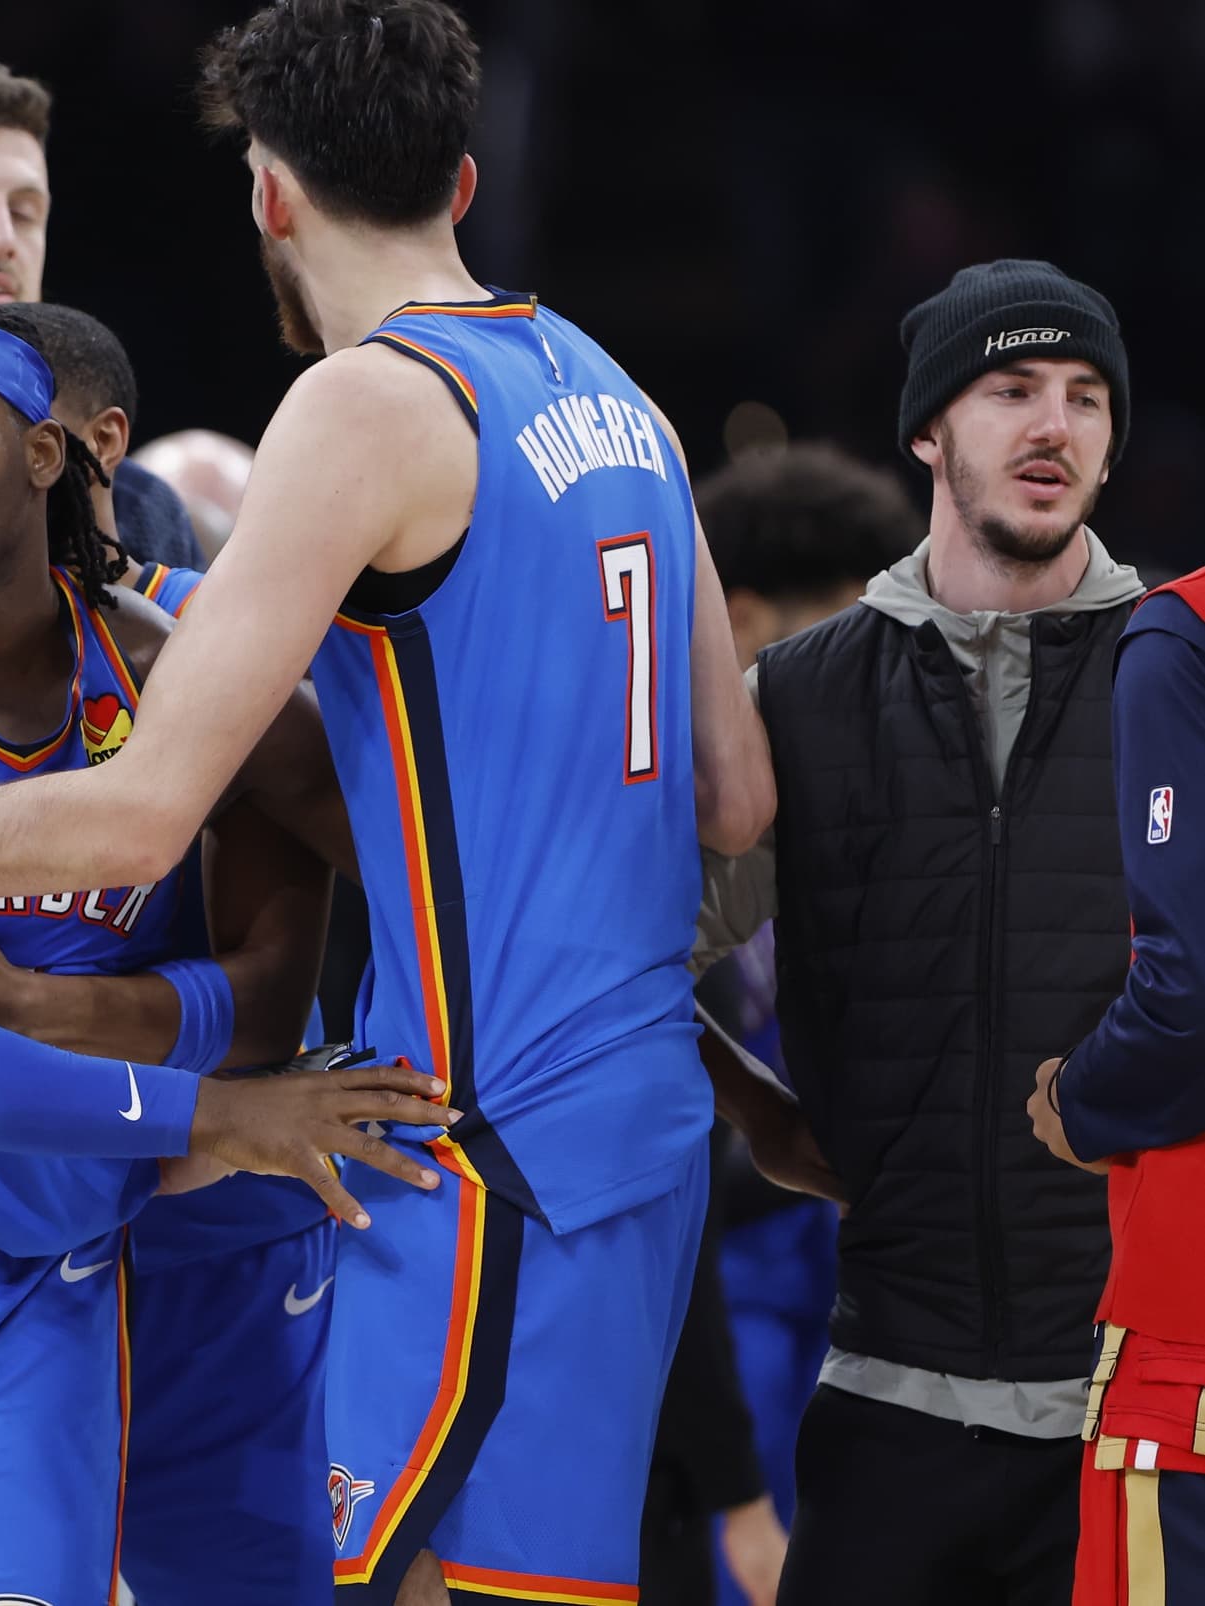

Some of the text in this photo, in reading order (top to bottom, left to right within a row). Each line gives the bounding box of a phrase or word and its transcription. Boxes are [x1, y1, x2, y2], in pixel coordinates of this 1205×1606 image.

[984, 328, 1071, 356] Honor
[515, 393, 668, 503] HOLMGREN
[596, 530, 659, 785] 7
